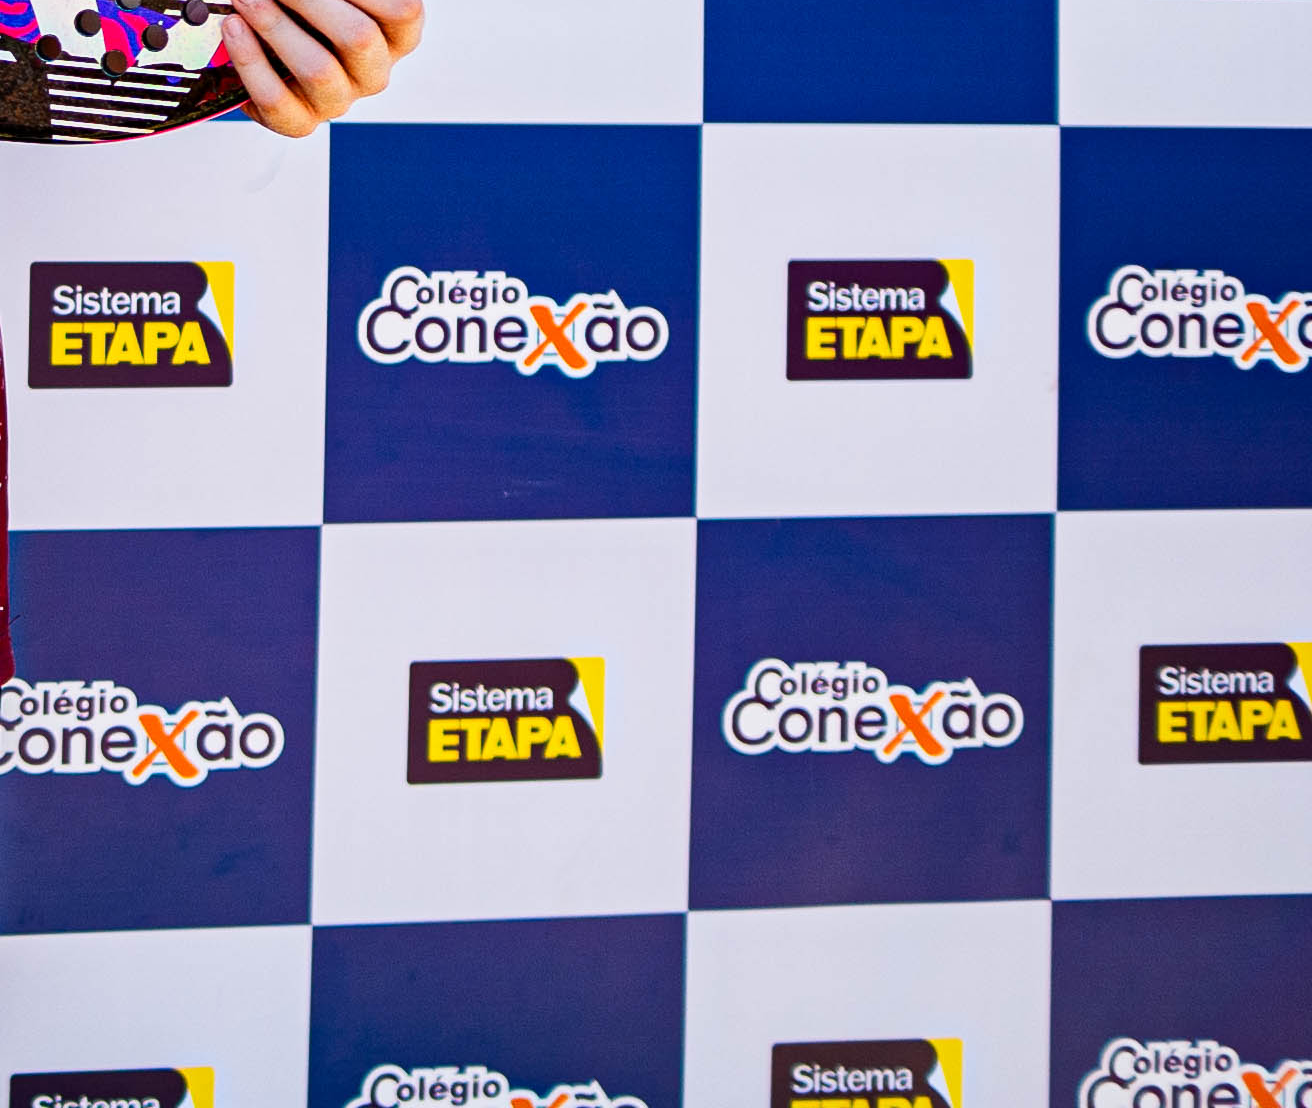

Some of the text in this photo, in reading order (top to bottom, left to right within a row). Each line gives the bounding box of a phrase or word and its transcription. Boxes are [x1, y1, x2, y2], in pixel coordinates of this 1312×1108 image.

[52, 286, 181, 314] Sistema
[389, 276, 519, 313] Colégio
[808, 282, 926, 311] Sistema
[1117, 274, 1237, 310] Colégio
[50, 322, 211, 365] ETAPA
[806, 317, 953, 359] ETAPA
[430, 681, 554, 712] Sistema
[756, 668, 879, 703] Colégio
[1159, 667, 1274, 694] Sistema
[1, 686, 128, 726] Colégio
[1157, 700, 1302, 742] ETAPA
[427, 716, 582, 762] ETAPA
[792, 1065, 913, 1092] Sistema
[1109, 1046, 1232, 1082] Colégio
[370, 1073, 500, 1106] Colégio
